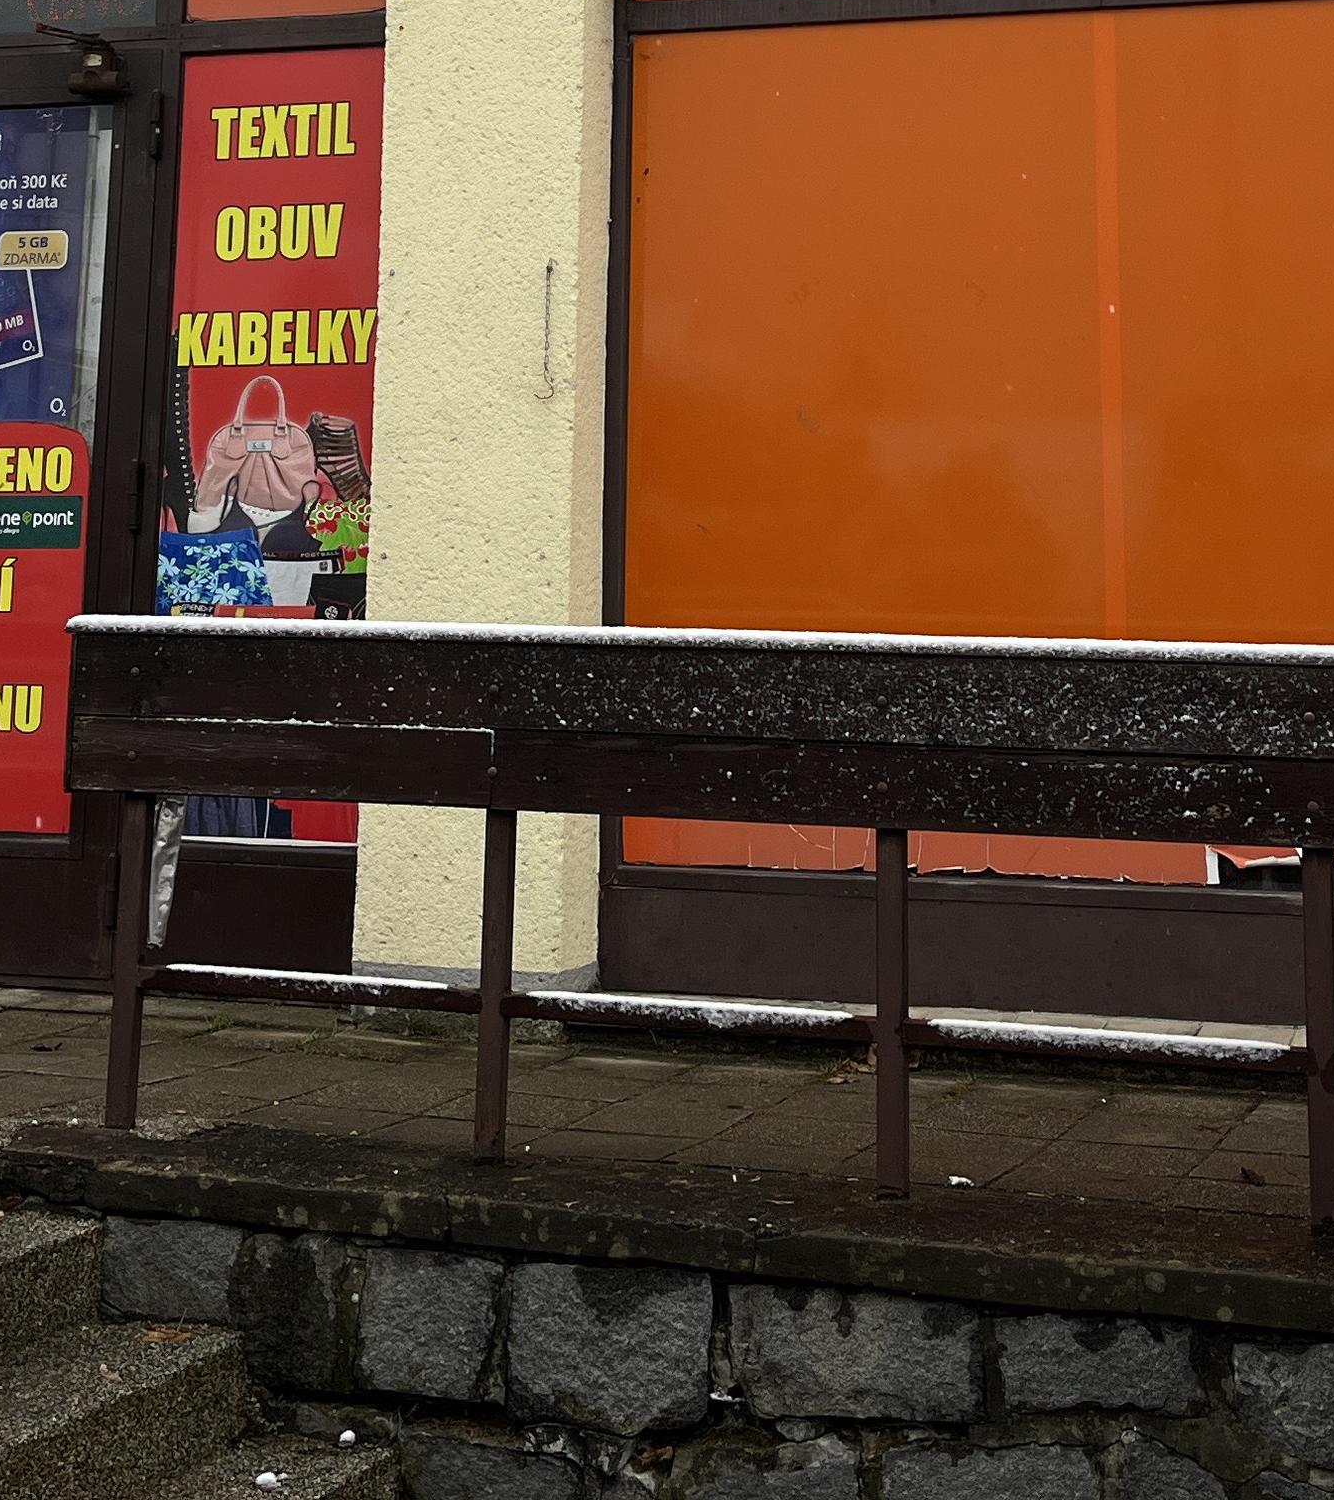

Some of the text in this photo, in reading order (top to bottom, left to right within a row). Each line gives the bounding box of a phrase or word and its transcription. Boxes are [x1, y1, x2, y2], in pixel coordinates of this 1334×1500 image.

[211, 102, 356, 160] TEXTIL
[21, 175, 48, 189] 300
[51, 173, 67, 188] Kč
[12, 196, 23, 210] si
[26, 195, 58, 210] data
[216, 203, 344, 261] OBUV
[19, 236, 48, 248] 5 GB
[5, 314, 24, 330] MB
[177, 309, 377, 367] KABELKY
[33, 510, 74, 528] point
